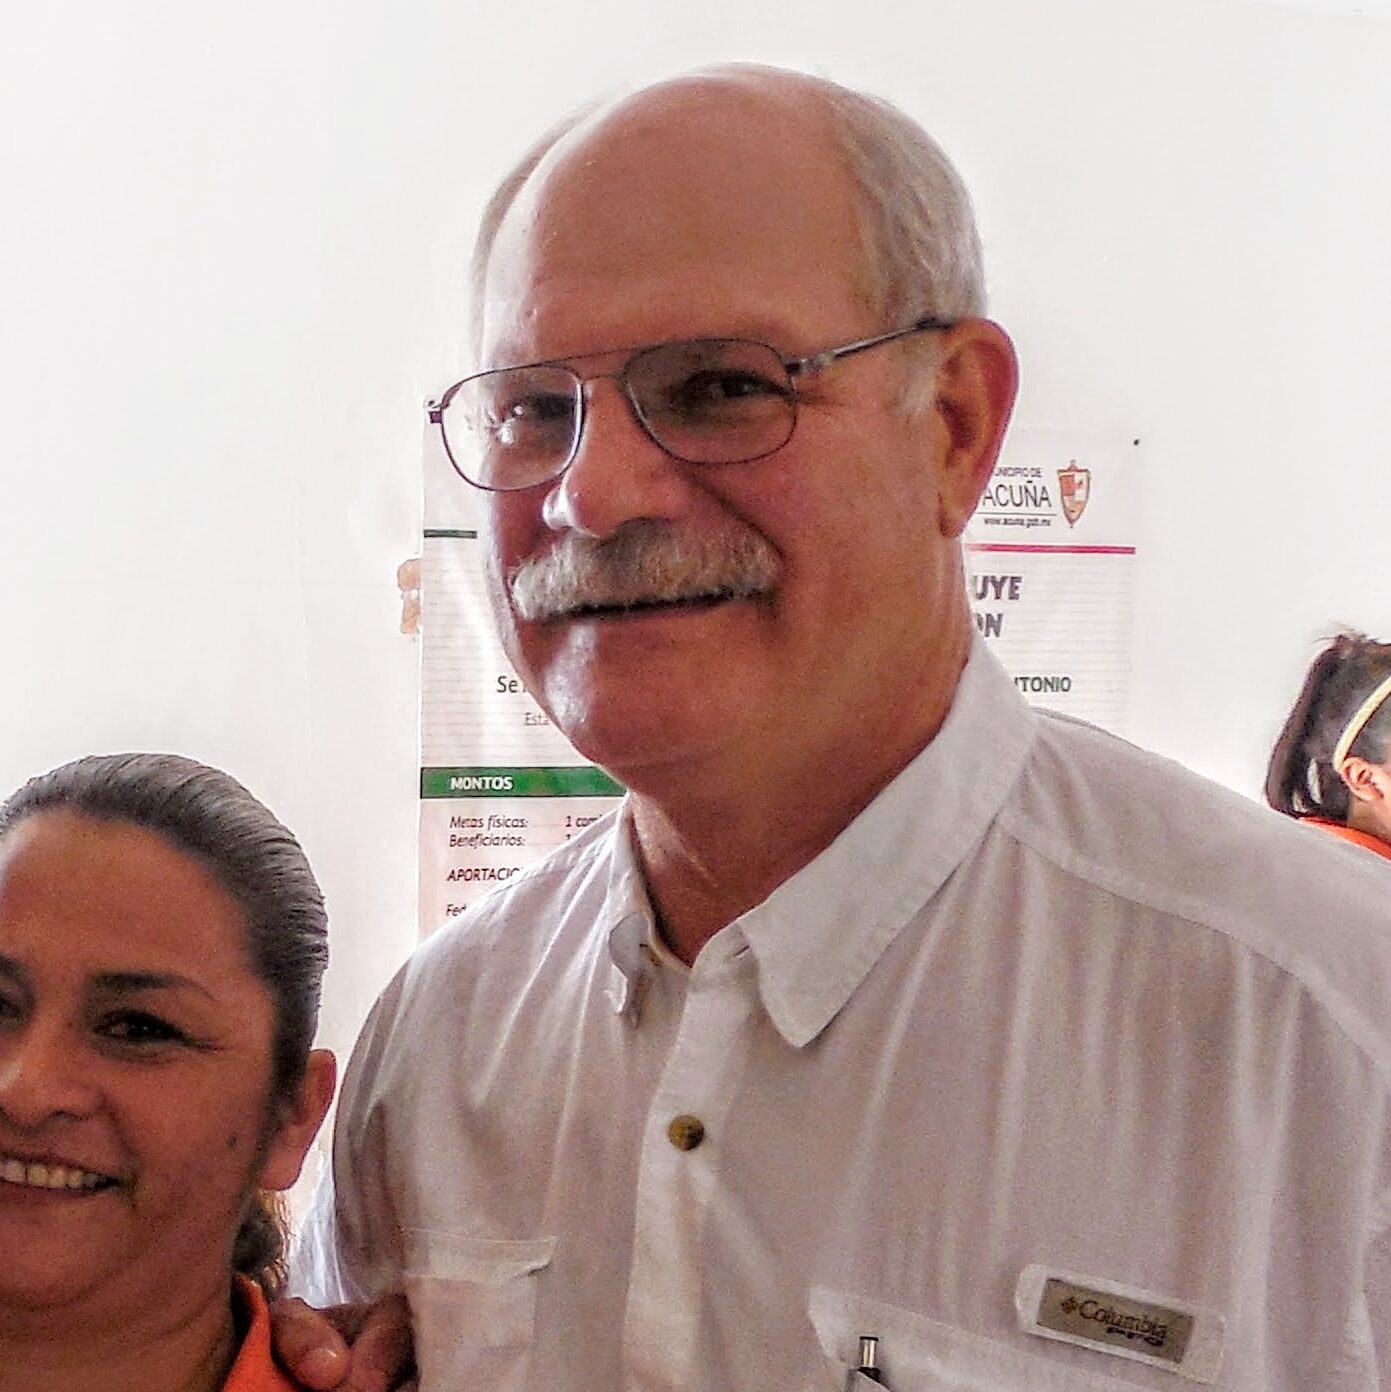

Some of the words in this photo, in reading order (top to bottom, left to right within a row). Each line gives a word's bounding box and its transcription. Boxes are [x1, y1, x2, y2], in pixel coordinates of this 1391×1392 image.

[982, 480, 1052, 507] ACUÑA
[450, 777, 514, 791] MONTOS
[450, 816, 484, 828] Metas
[487, 814, 529, 831] físicas:
[565, 815, 572, 827] 1
[449, 834, 526, 849] Beneficiarios:
[1079, 1299, 1169, 1338] Columbia
